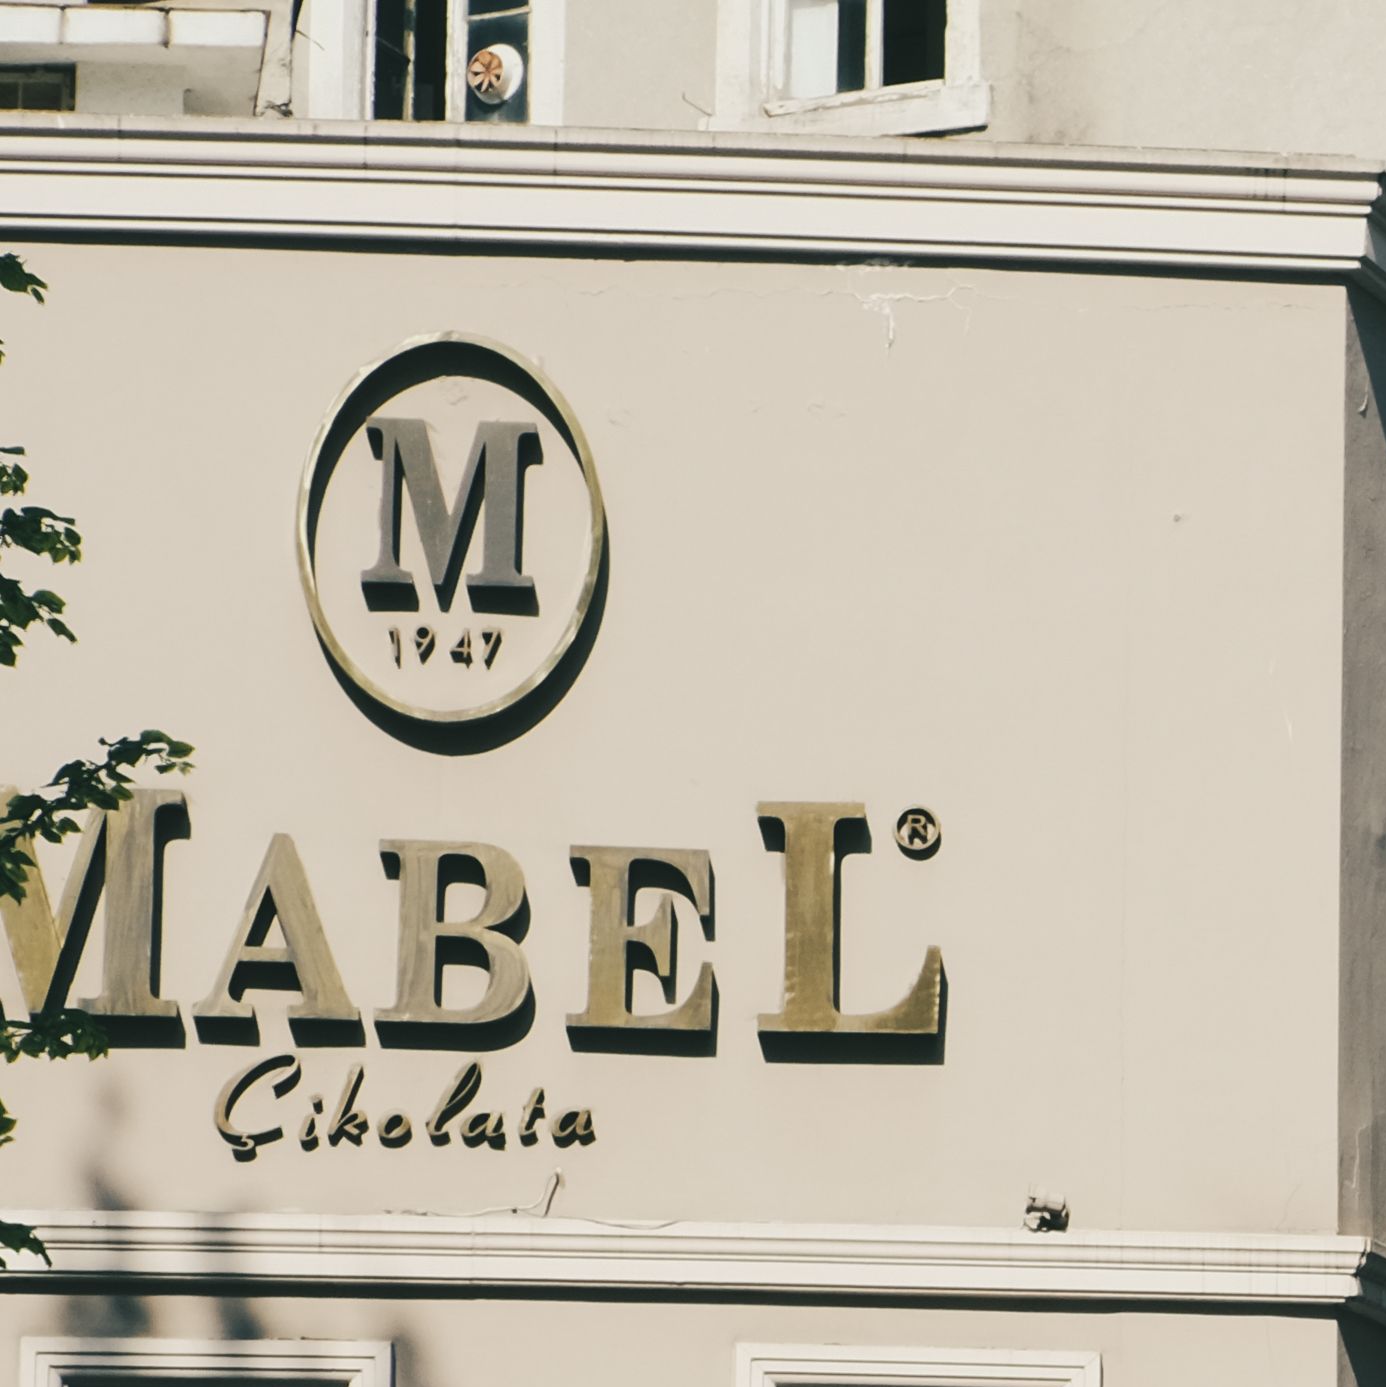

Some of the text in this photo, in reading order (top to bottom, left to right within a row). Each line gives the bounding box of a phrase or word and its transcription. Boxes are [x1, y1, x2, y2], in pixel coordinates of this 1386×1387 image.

[361, 416, 543, 616] M
[388, 626, 503, 670] 1947
[213, 1053, 597, 1163] Çikolata
